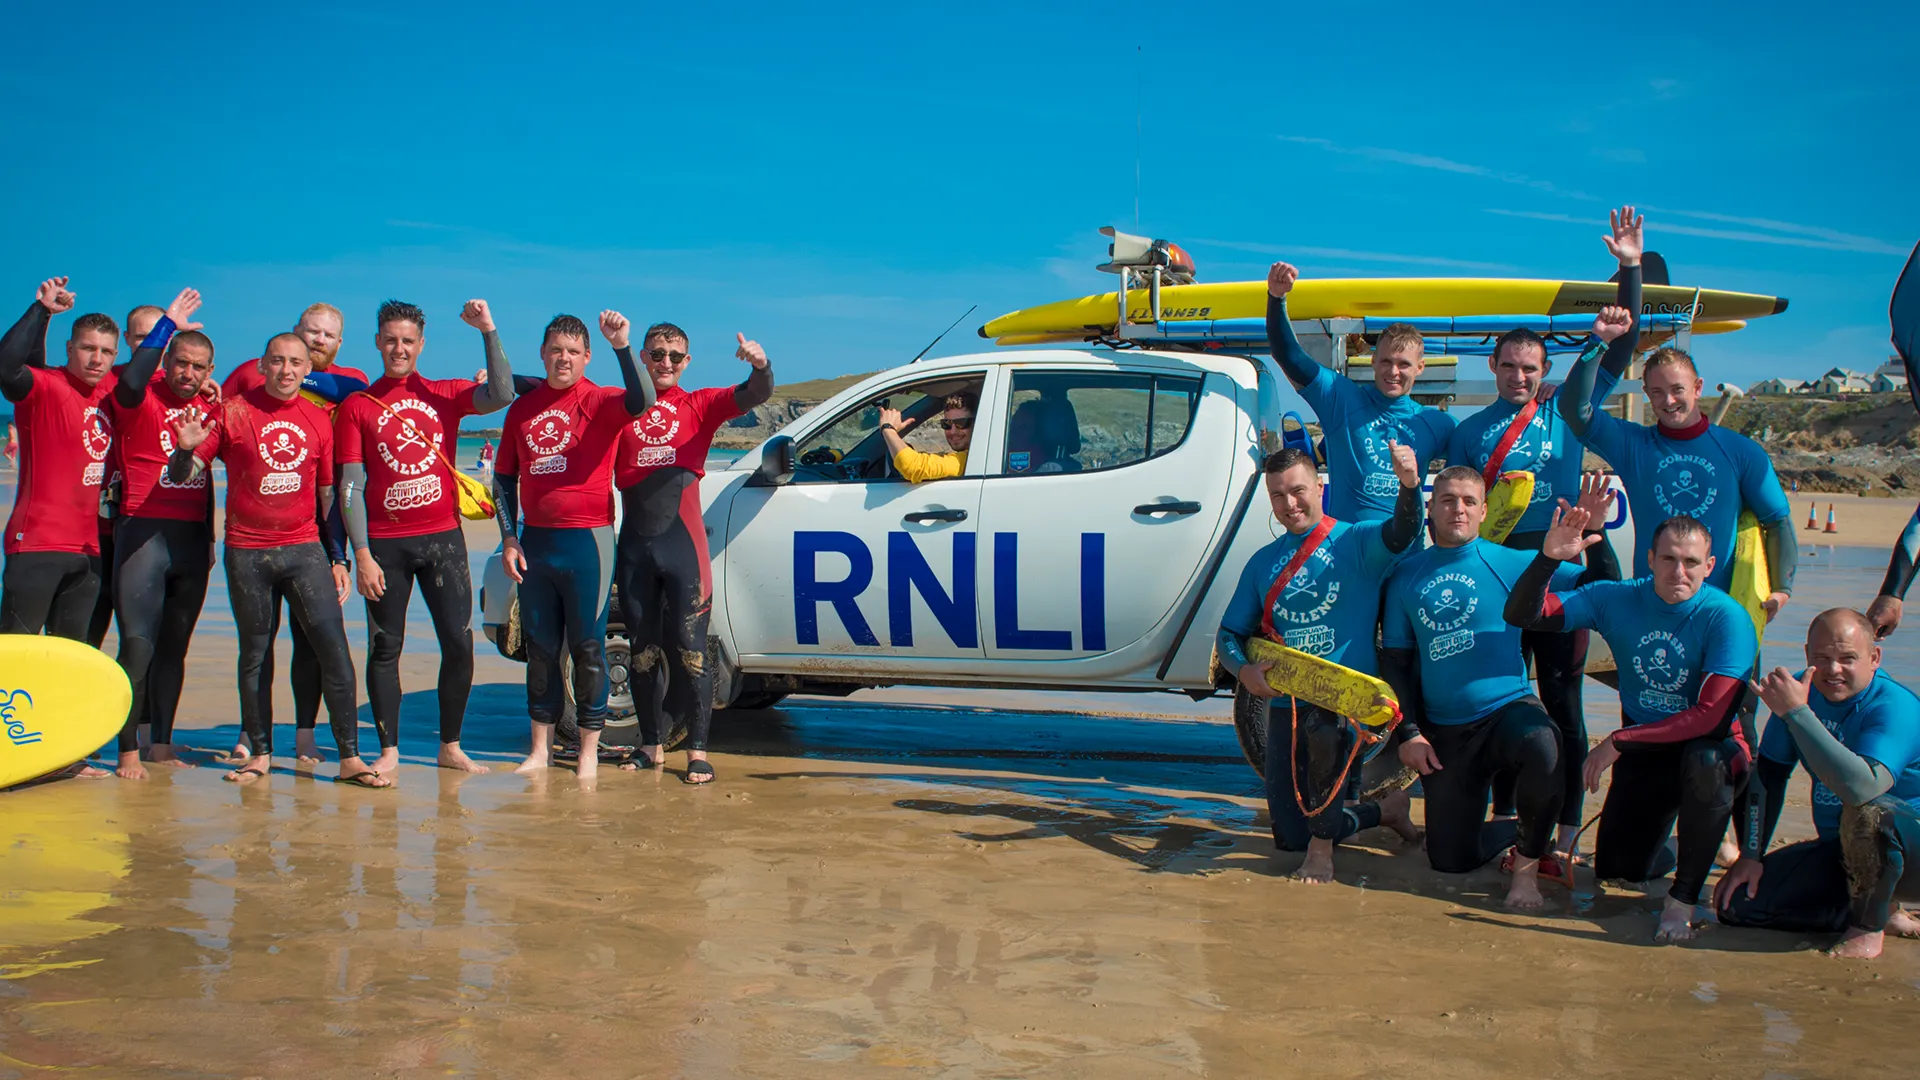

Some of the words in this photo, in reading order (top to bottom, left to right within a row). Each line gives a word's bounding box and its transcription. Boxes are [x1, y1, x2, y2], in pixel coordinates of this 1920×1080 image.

[1127, 307, 1212, 320] BENNTT
[526, 430, 571, 455] CHALLENGE
[633, 420, 680, 445] CHALLENGE
[259, 443, 308, 471] CHALLENGE
[377, 433, 443, 475] CHALLENGE
[387, 485, 418, 498] ACTIVITY
[420, 480, 440, 492] CENTRE
[395, 477, 434, 488] NEWQUAY
[793, 530, 1107, 652] RNLI
[1271, 581, 1341, 623] HALLENGE
[1418, 597, 1479, 632] CHALLENGE
[1285, 636, 1307, 647] TIVITY
[1308, 629, 1334, 644] CENTRE
[1286, 626, 1325, 637] NEWQUAY
[1632, 656, 1690, 692] CHALLENGE
